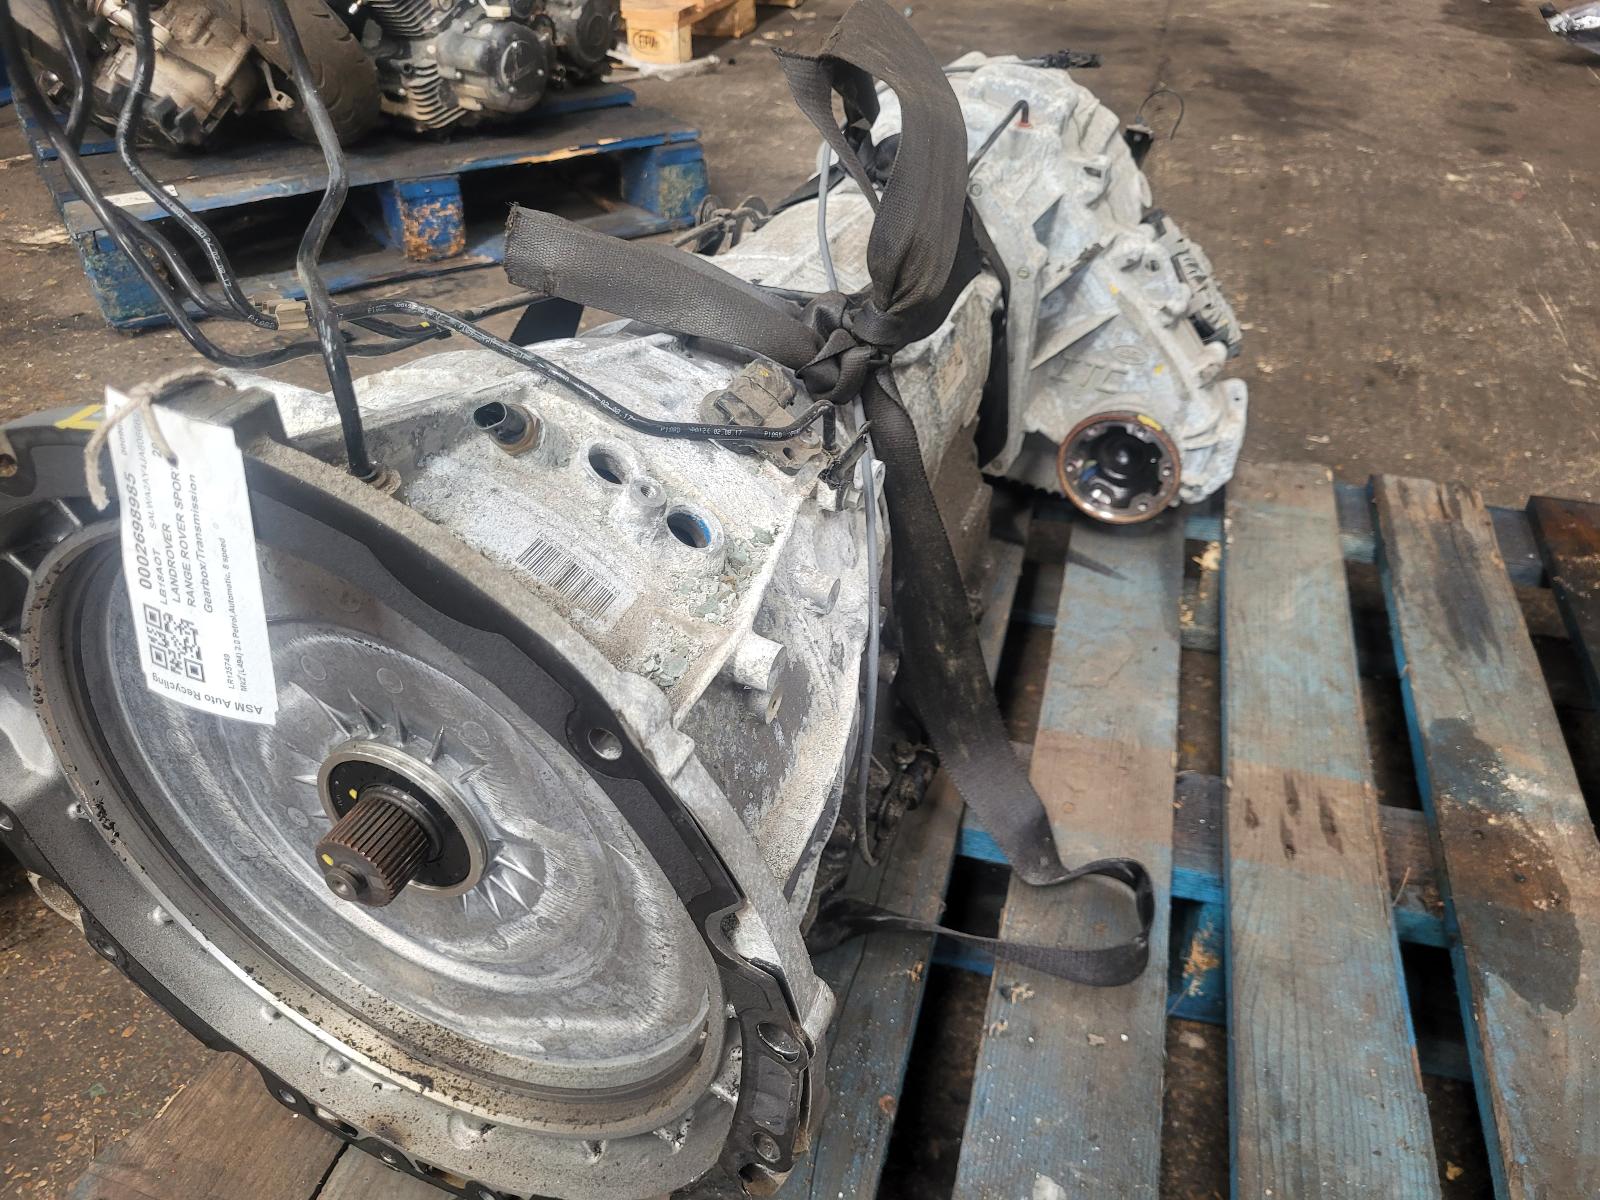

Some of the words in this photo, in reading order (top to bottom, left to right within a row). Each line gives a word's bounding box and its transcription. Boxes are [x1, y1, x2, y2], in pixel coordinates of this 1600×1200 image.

[123, 471, 153, 590] 0002698985
[175, 512, 190, 559] ROVER
[189, 474, 214, 613] Gearbox/Transmission
[217, 537, 231, 562] speed
[151, 547, 168, 605] LB18AOT
[161, 522, 181, 603] LANDROVER
[181, 562, 197, 607] RANGE
[152, 672, 201, 700] Recycling
[204, 693, 232, 709] Auto
[235, 700, 264, 715] ASM
